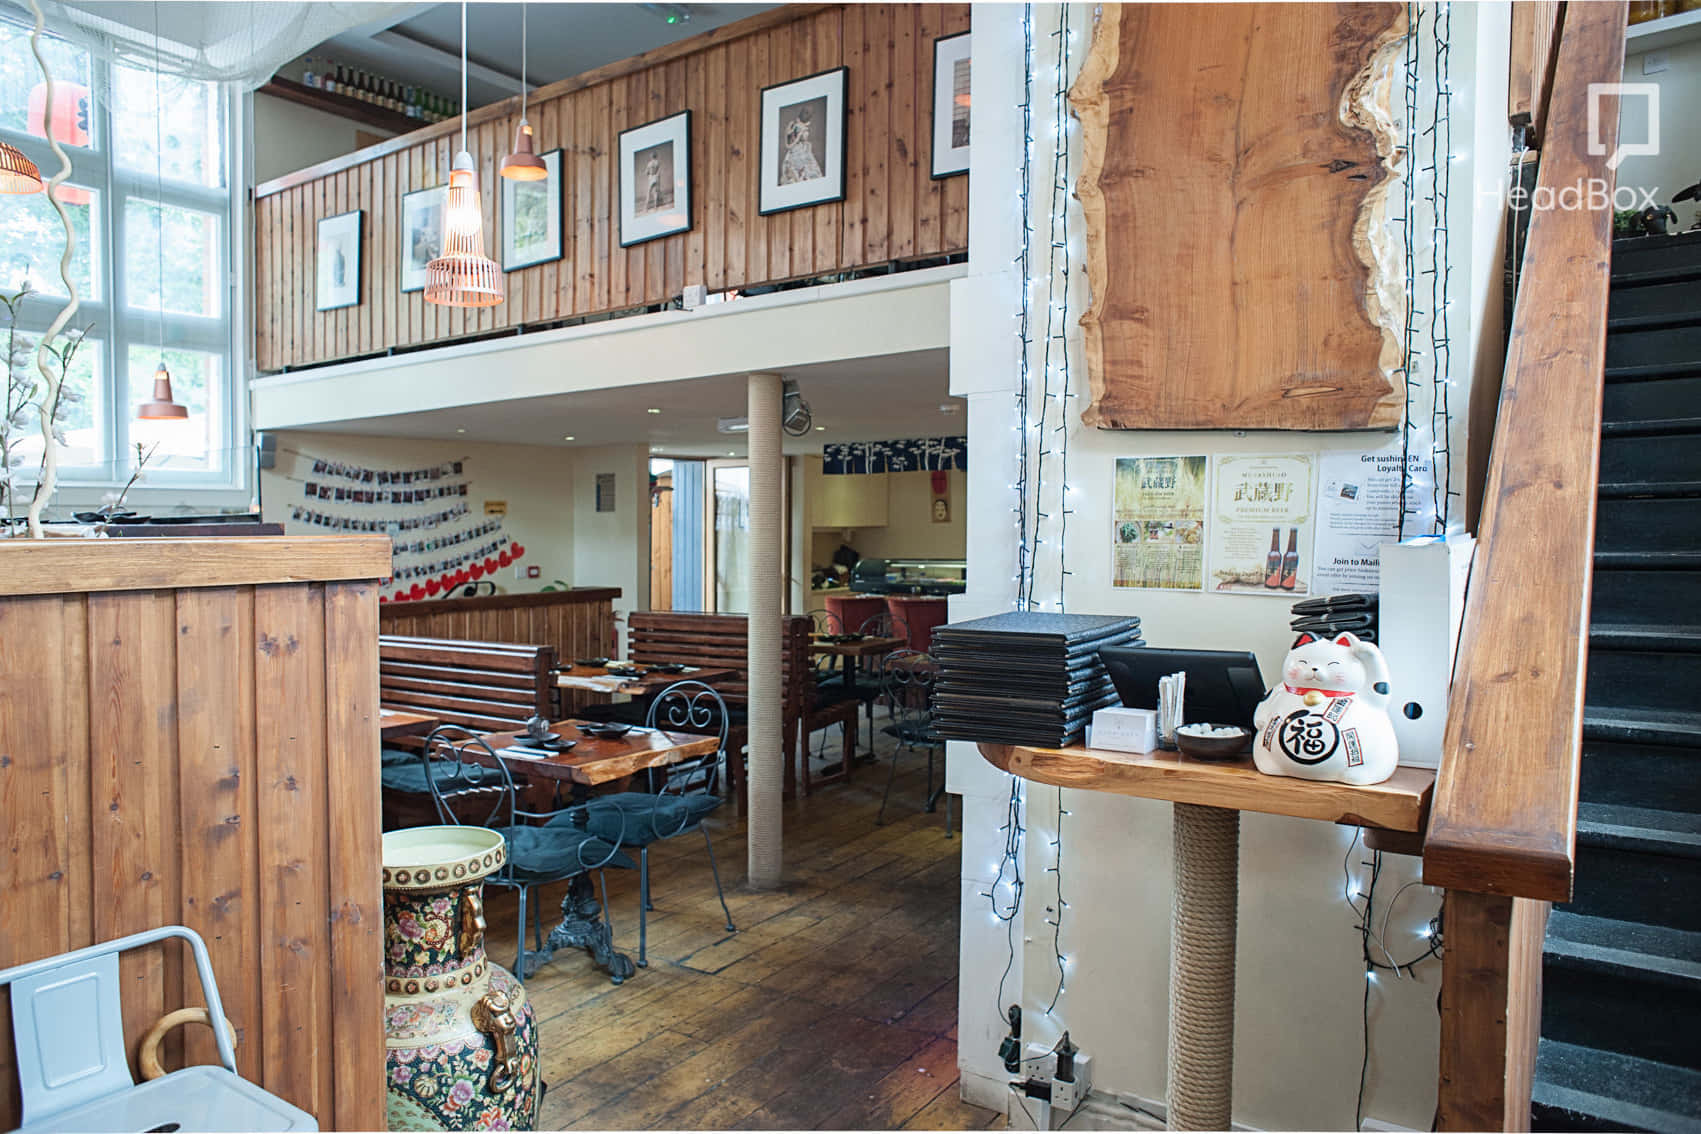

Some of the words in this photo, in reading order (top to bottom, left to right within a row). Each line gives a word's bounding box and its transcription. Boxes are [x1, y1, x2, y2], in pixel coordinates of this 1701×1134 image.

[1361, 455, 1375, 463] Get
[1376, 455, 1419, 463] sushinEN
[1377, 464, 1406, 474] Loyalt
[1332, 557, 1349, 565] Join
[1351, 558, 1360, 566] to
[1286, 718, 1325, 755] 福
